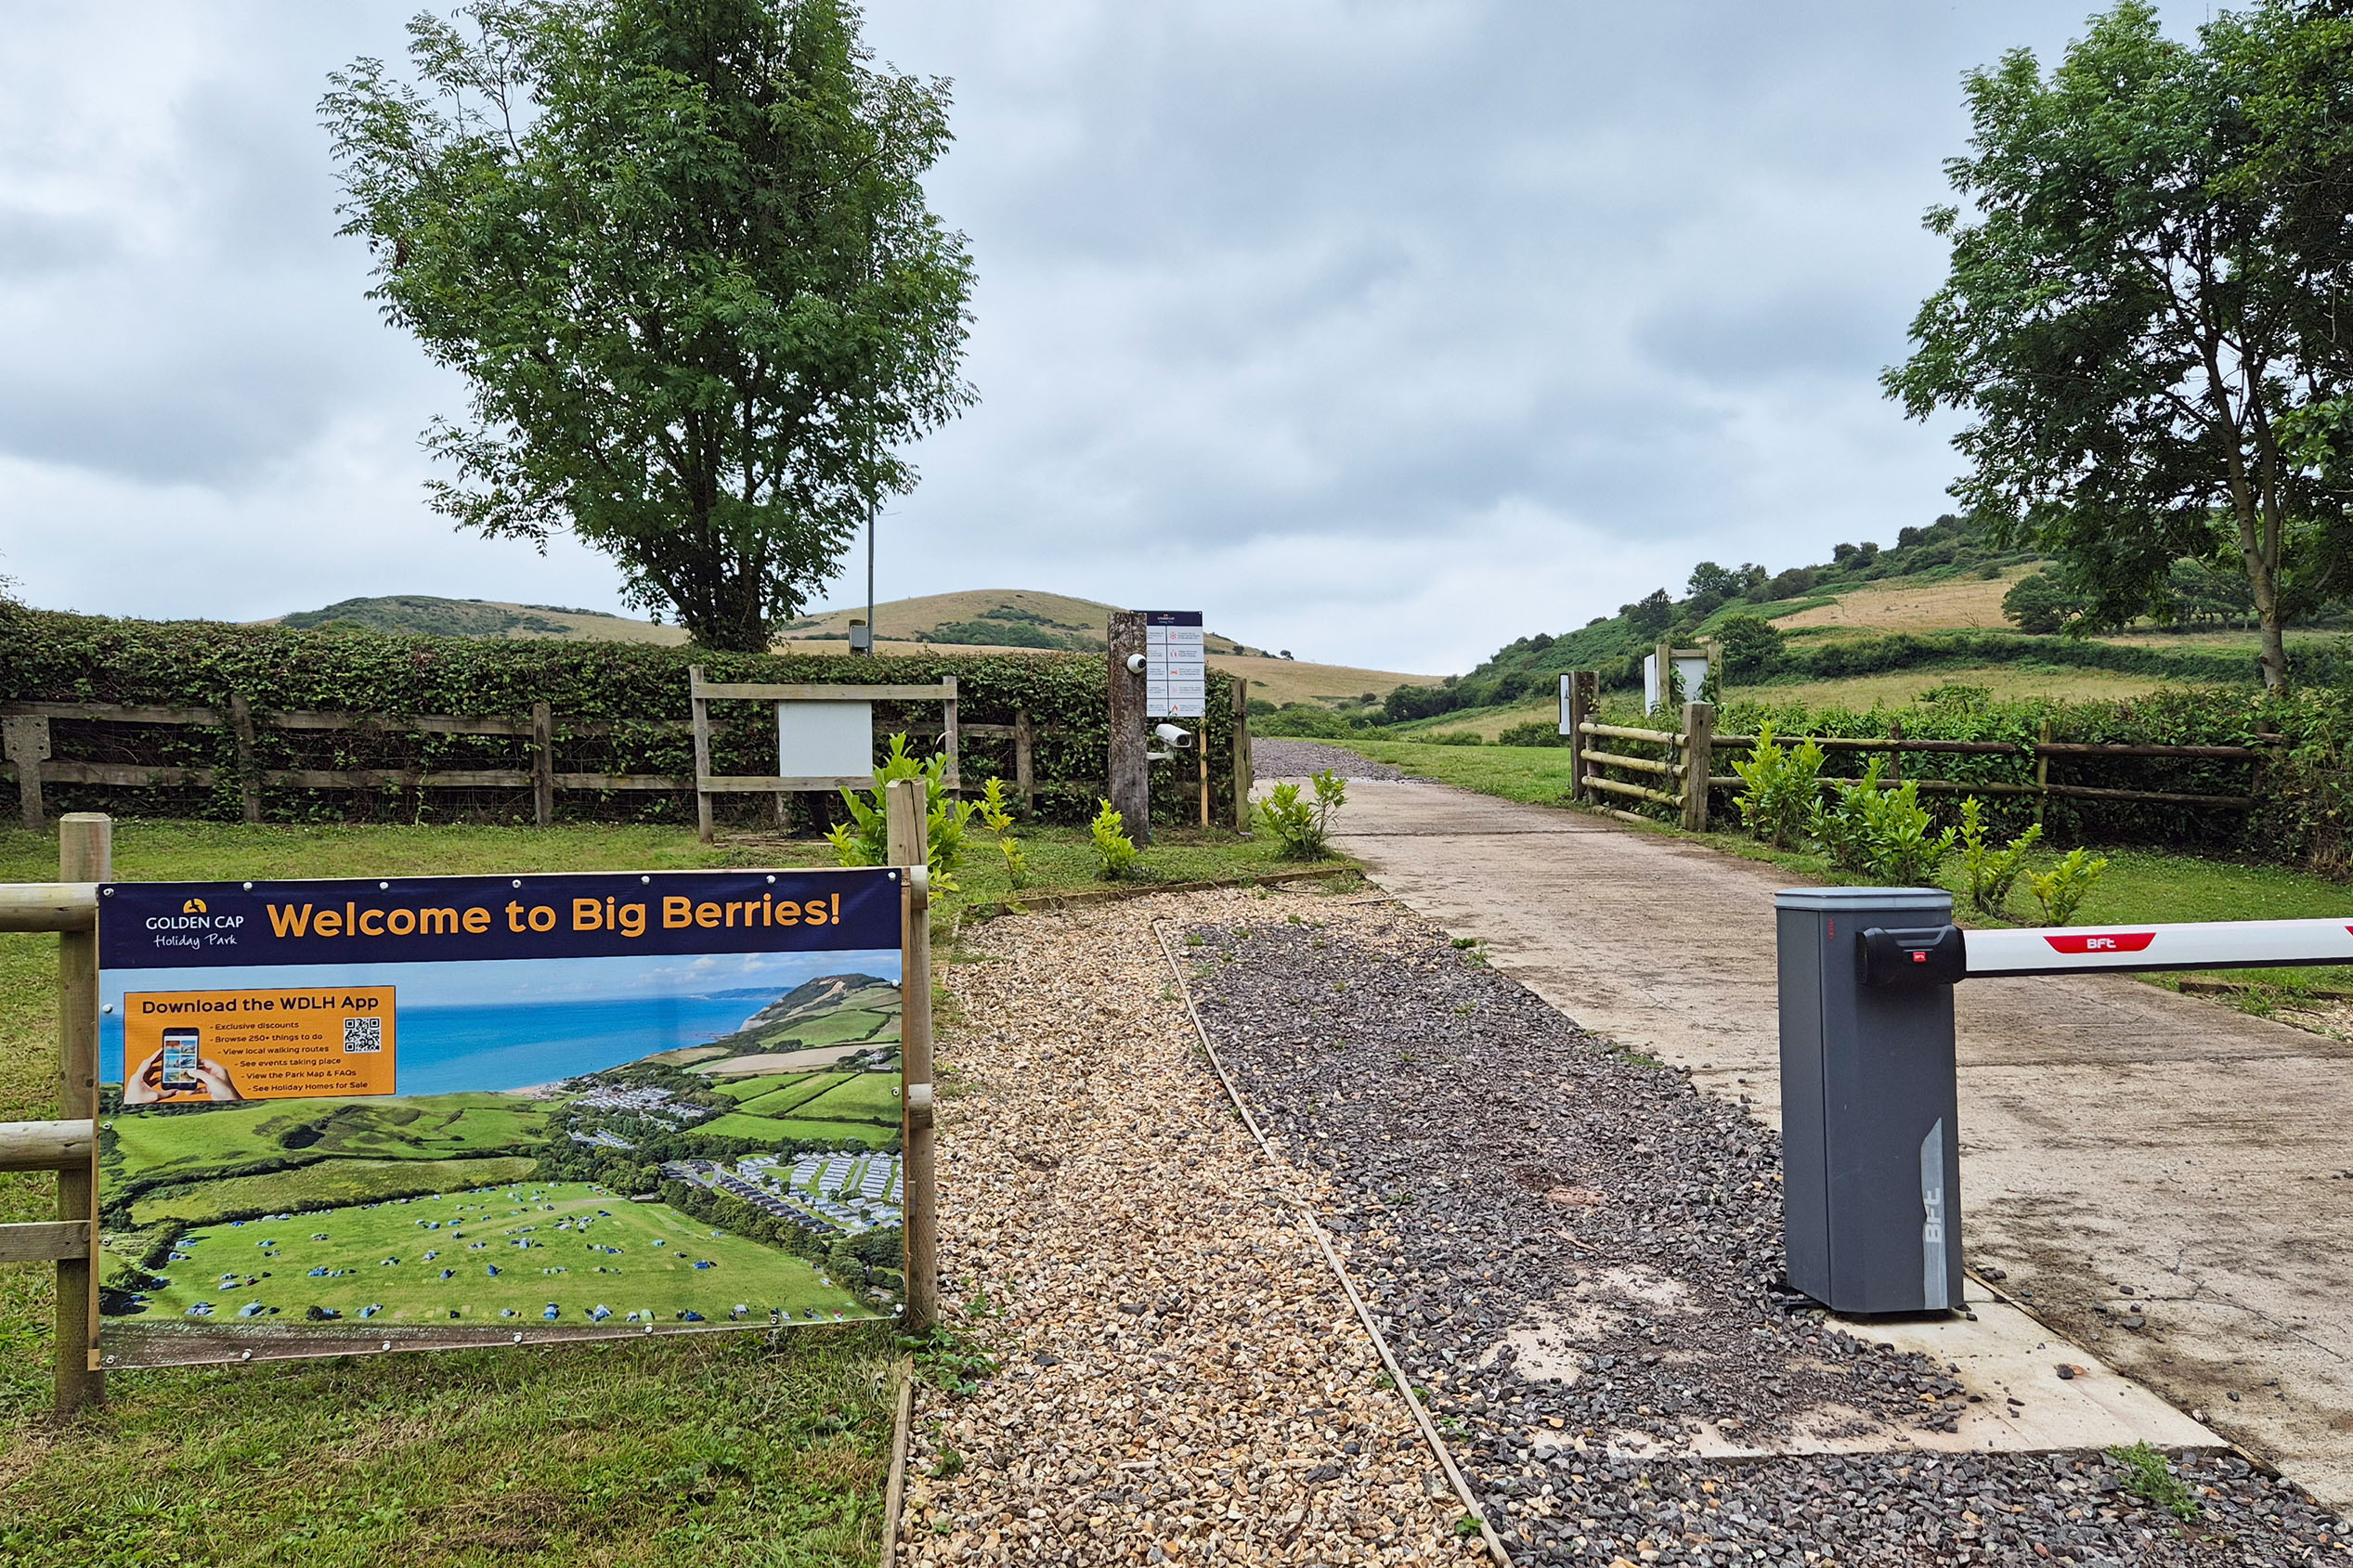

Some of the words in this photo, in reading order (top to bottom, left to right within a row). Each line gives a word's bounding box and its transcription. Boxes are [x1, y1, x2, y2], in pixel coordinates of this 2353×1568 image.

[266, 901, 491, 938] Welcome
[504, 900, 557, 933] to
[572, 896, 646, 938] Big
[662, 893, 840, 928] Berries!
[146, 915, 210, 929] GOLDEN
[214, 915, 244, 928] CAP
[153, 934, 201, 950] Holiday
[204, 933, 238, 945] Park
[142, 998, 237, 1014] Download
[242, 997, 275, 1011] the
[280, 995, 335, 1010] WDLH
[341, 995, 379, 1011] App
[257, 1021, 300, 1030] discounts
[272, 1033, 299, 1042] things
[245, 1046, 266, 1055] local
[267, 1045, 300, 1055] walking
[290, 1057, 317, 1067] taking
[318, 1057, 341, 1066] place
[306, 1070, 325, 1079] Map
[271, 1082, 304, 1091] Holiday
